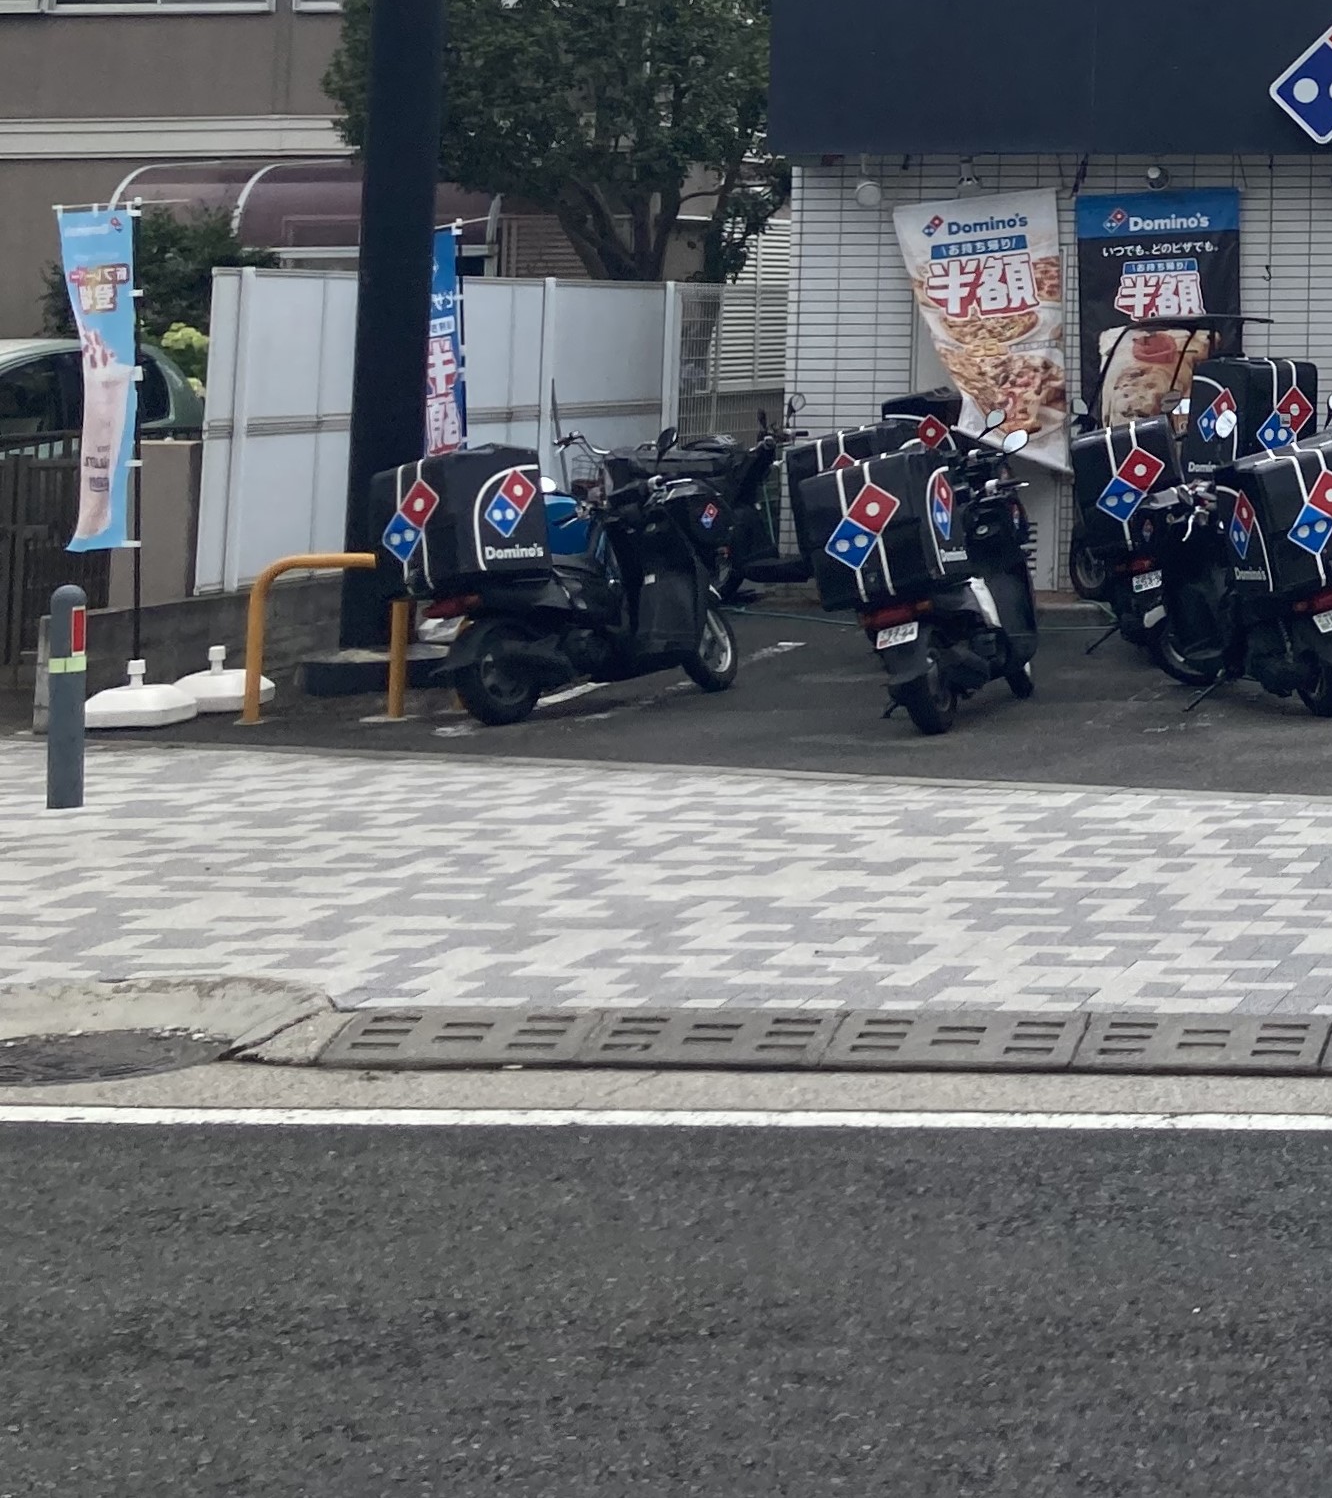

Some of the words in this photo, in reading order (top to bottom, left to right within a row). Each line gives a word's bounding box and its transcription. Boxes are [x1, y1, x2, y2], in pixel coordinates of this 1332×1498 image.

[947, 213, 1028, 235] Domino's
[1129, 213, 1210, 232] Domino's
[926, 253, 1040, 315] 半額
[1117, 274, 1204, 317] 半額
[485, 542, 544, 560] Domino's
